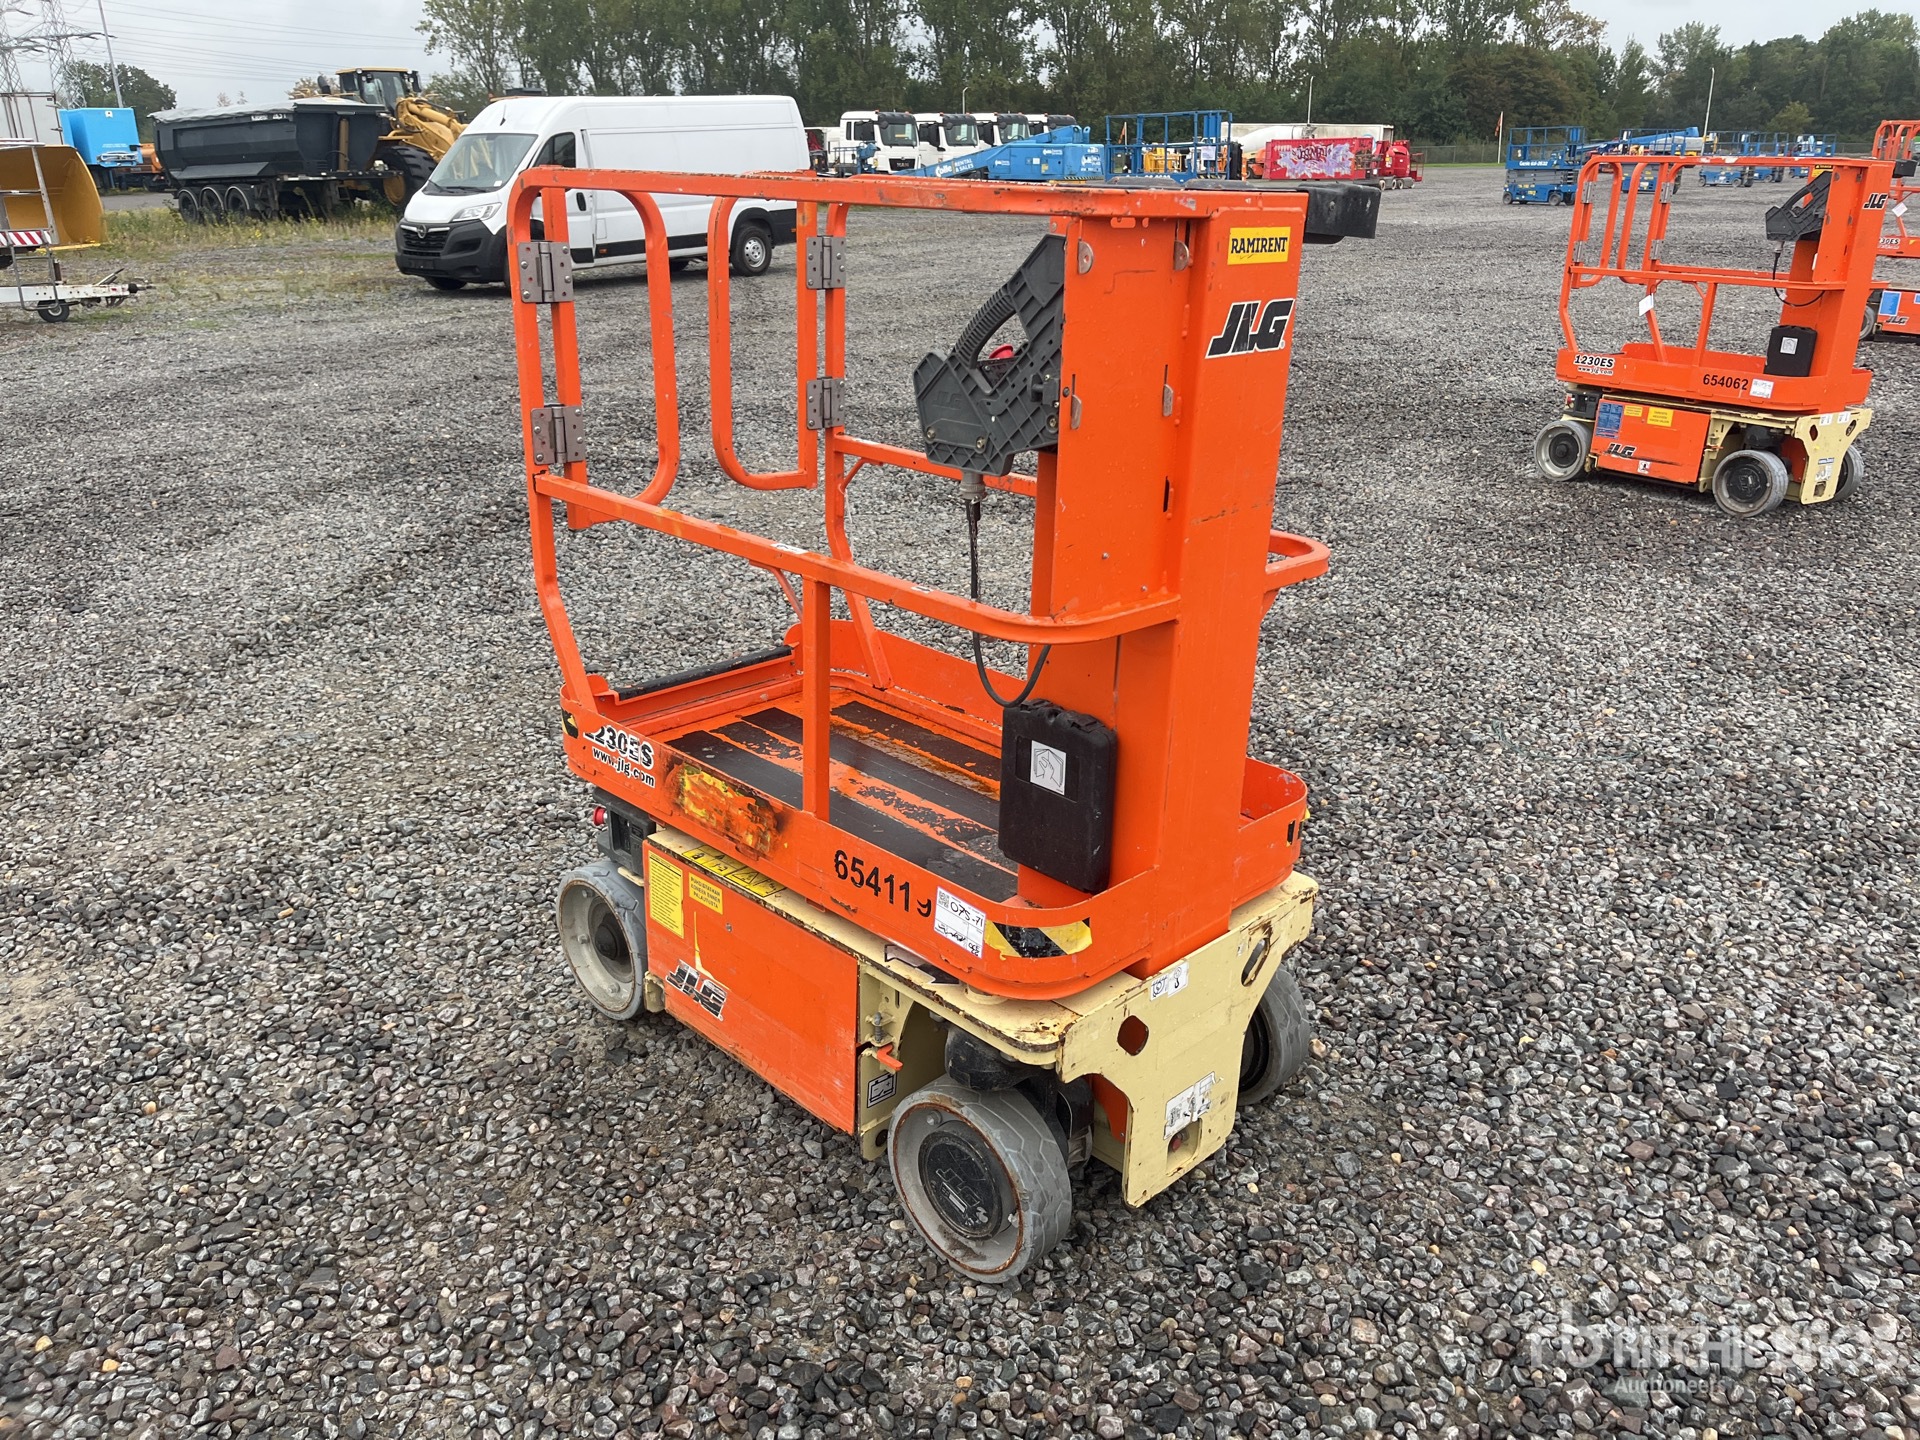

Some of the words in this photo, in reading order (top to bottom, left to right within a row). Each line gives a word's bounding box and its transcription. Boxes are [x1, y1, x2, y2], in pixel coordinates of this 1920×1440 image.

[1863, 193, 1888, 209] JLG
[1231, 237, 1288, 254] RAMIRENT
[1205, 299, 1295, 359] JLG
[1885, 315, 1908, 326] JLG
[1574, 354, 1614, 368] 1230ES
[1703, 373, 1749, 390] 654062
[665, 959, 728, 1020] JLG
